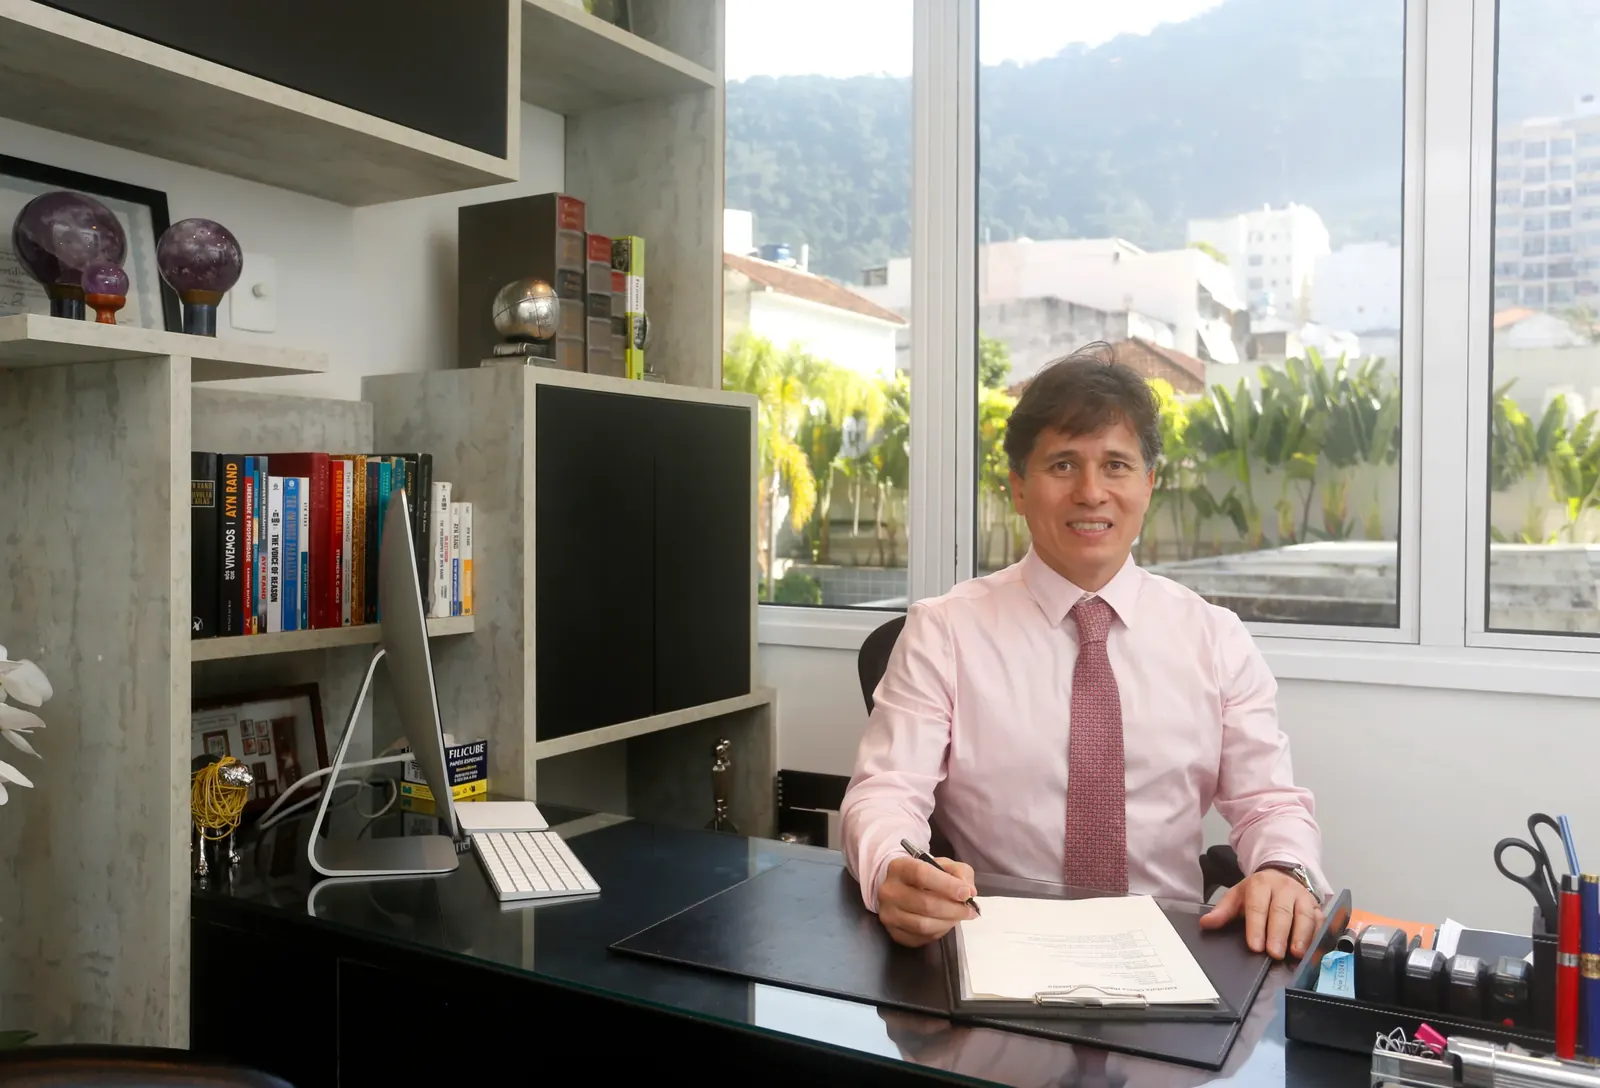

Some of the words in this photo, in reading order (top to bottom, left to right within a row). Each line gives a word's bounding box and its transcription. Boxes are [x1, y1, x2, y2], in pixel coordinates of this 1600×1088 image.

[226, 463, 238, 493] RAND
[226, 496, 238, 518] AYN
[346, 500, 351, 508] OF
[272, 534, 280, 546] THE
[225, 529, 236, 569] VIVEMOS
[270, 546, 279, 566] VOICE
[270, 566, 278, 576] OF
[270, 576, 278, 603] REASON
[449, 744, 484, 759] FILICUBE
[450, 759, 464, 768] PAPÉIS
[464, 755, 483, 765] ESPECIAIS
